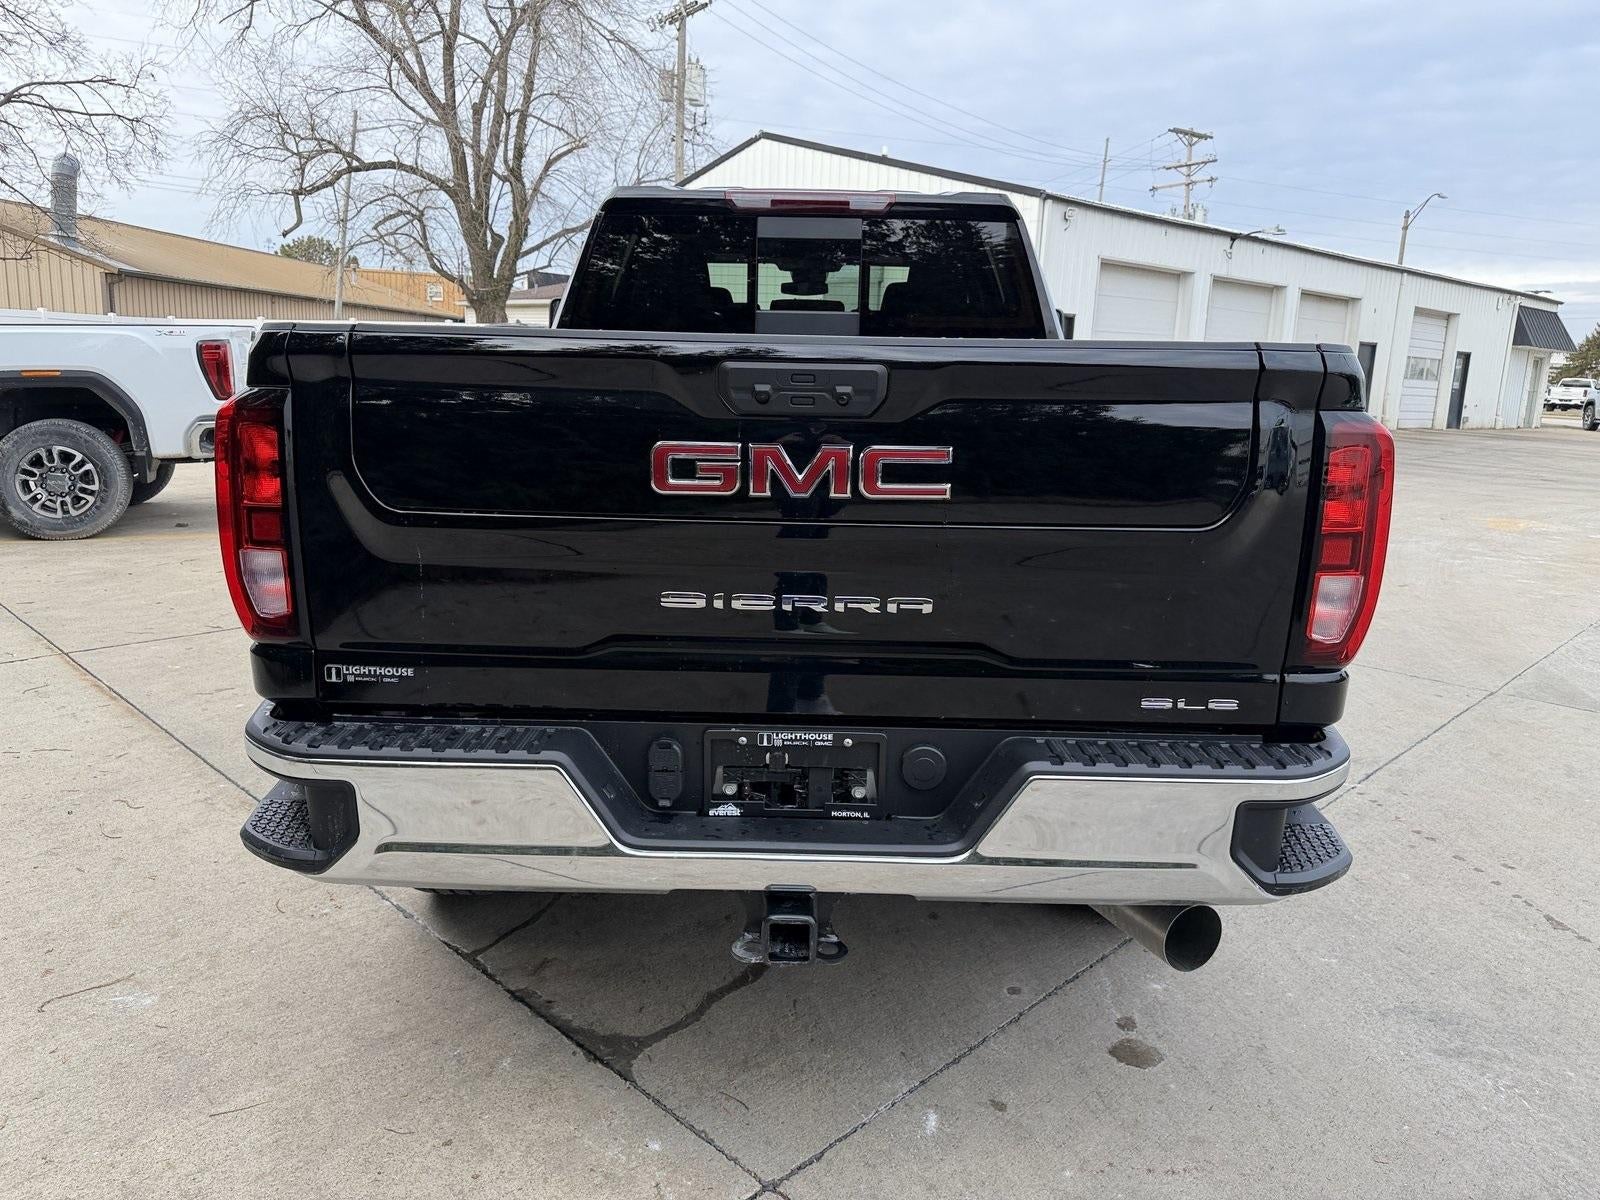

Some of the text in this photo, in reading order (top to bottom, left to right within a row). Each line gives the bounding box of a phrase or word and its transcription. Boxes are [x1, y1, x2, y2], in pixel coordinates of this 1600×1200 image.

[650, 440, 954, 500] GMC
[659, 591, 934, 615] SIERRA
[342, 665, 415, 677] LIGHTHOUSE
[773, 732, 834, 741] LIGHTHOUSE
[831, 811, 863, 819] MORTON,
